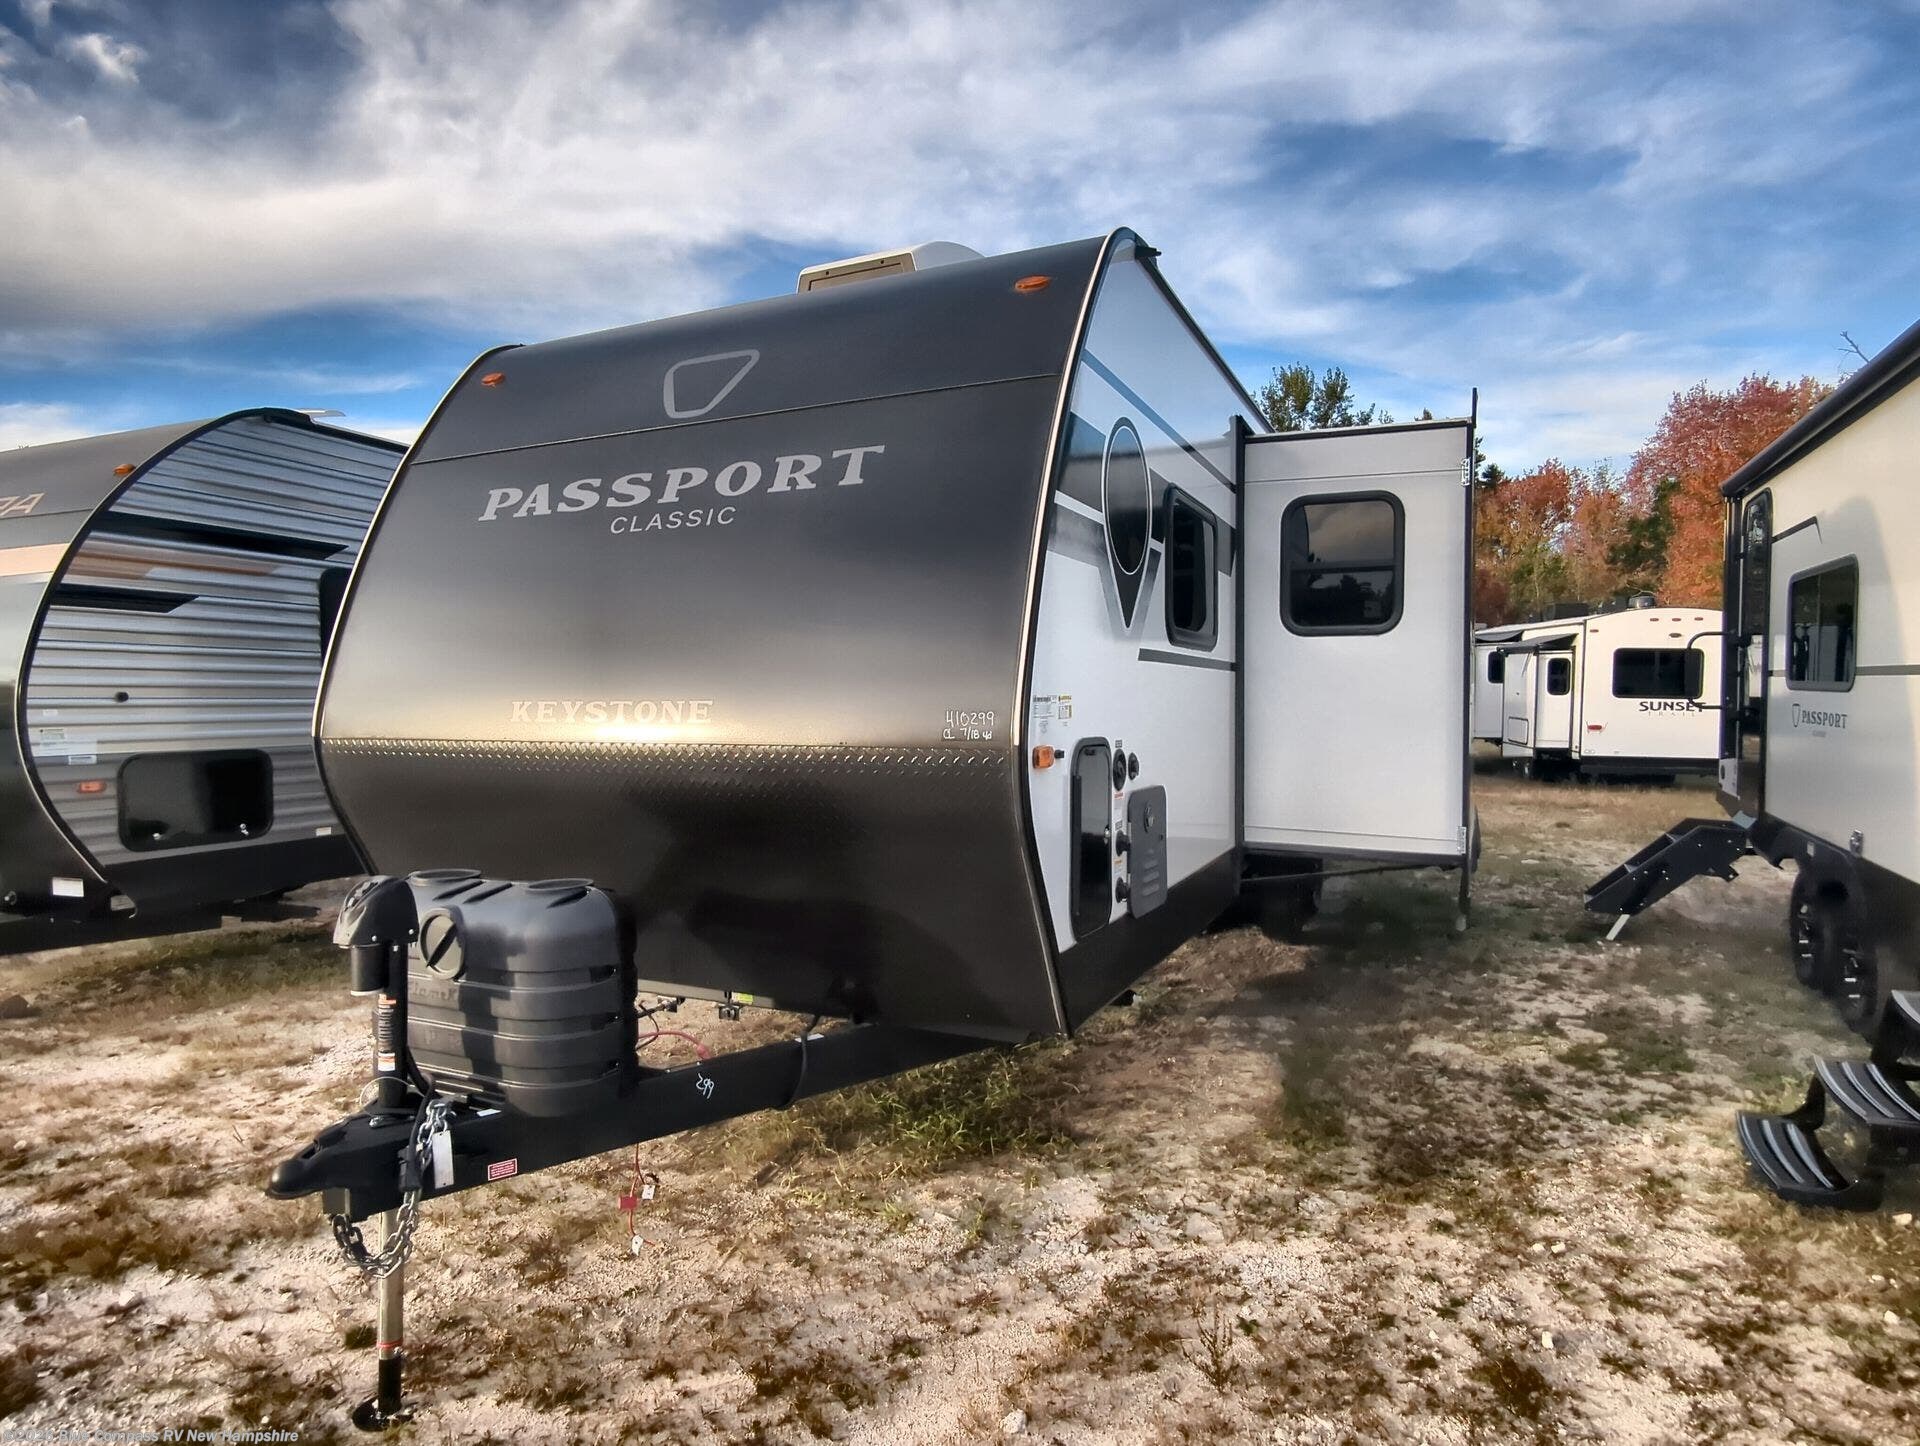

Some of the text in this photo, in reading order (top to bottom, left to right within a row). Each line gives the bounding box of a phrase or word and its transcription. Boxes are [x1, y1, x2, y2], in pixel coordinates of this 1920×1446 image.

[478, 445, 885, 521] PASSPORT
[610, 506, 736, 534] CLASSIC
[510, 700, 714, 723] KEYSTONE
[946, 710, 994, 727] 410299
[1802, 710, 1847, 728] PASSPORT
